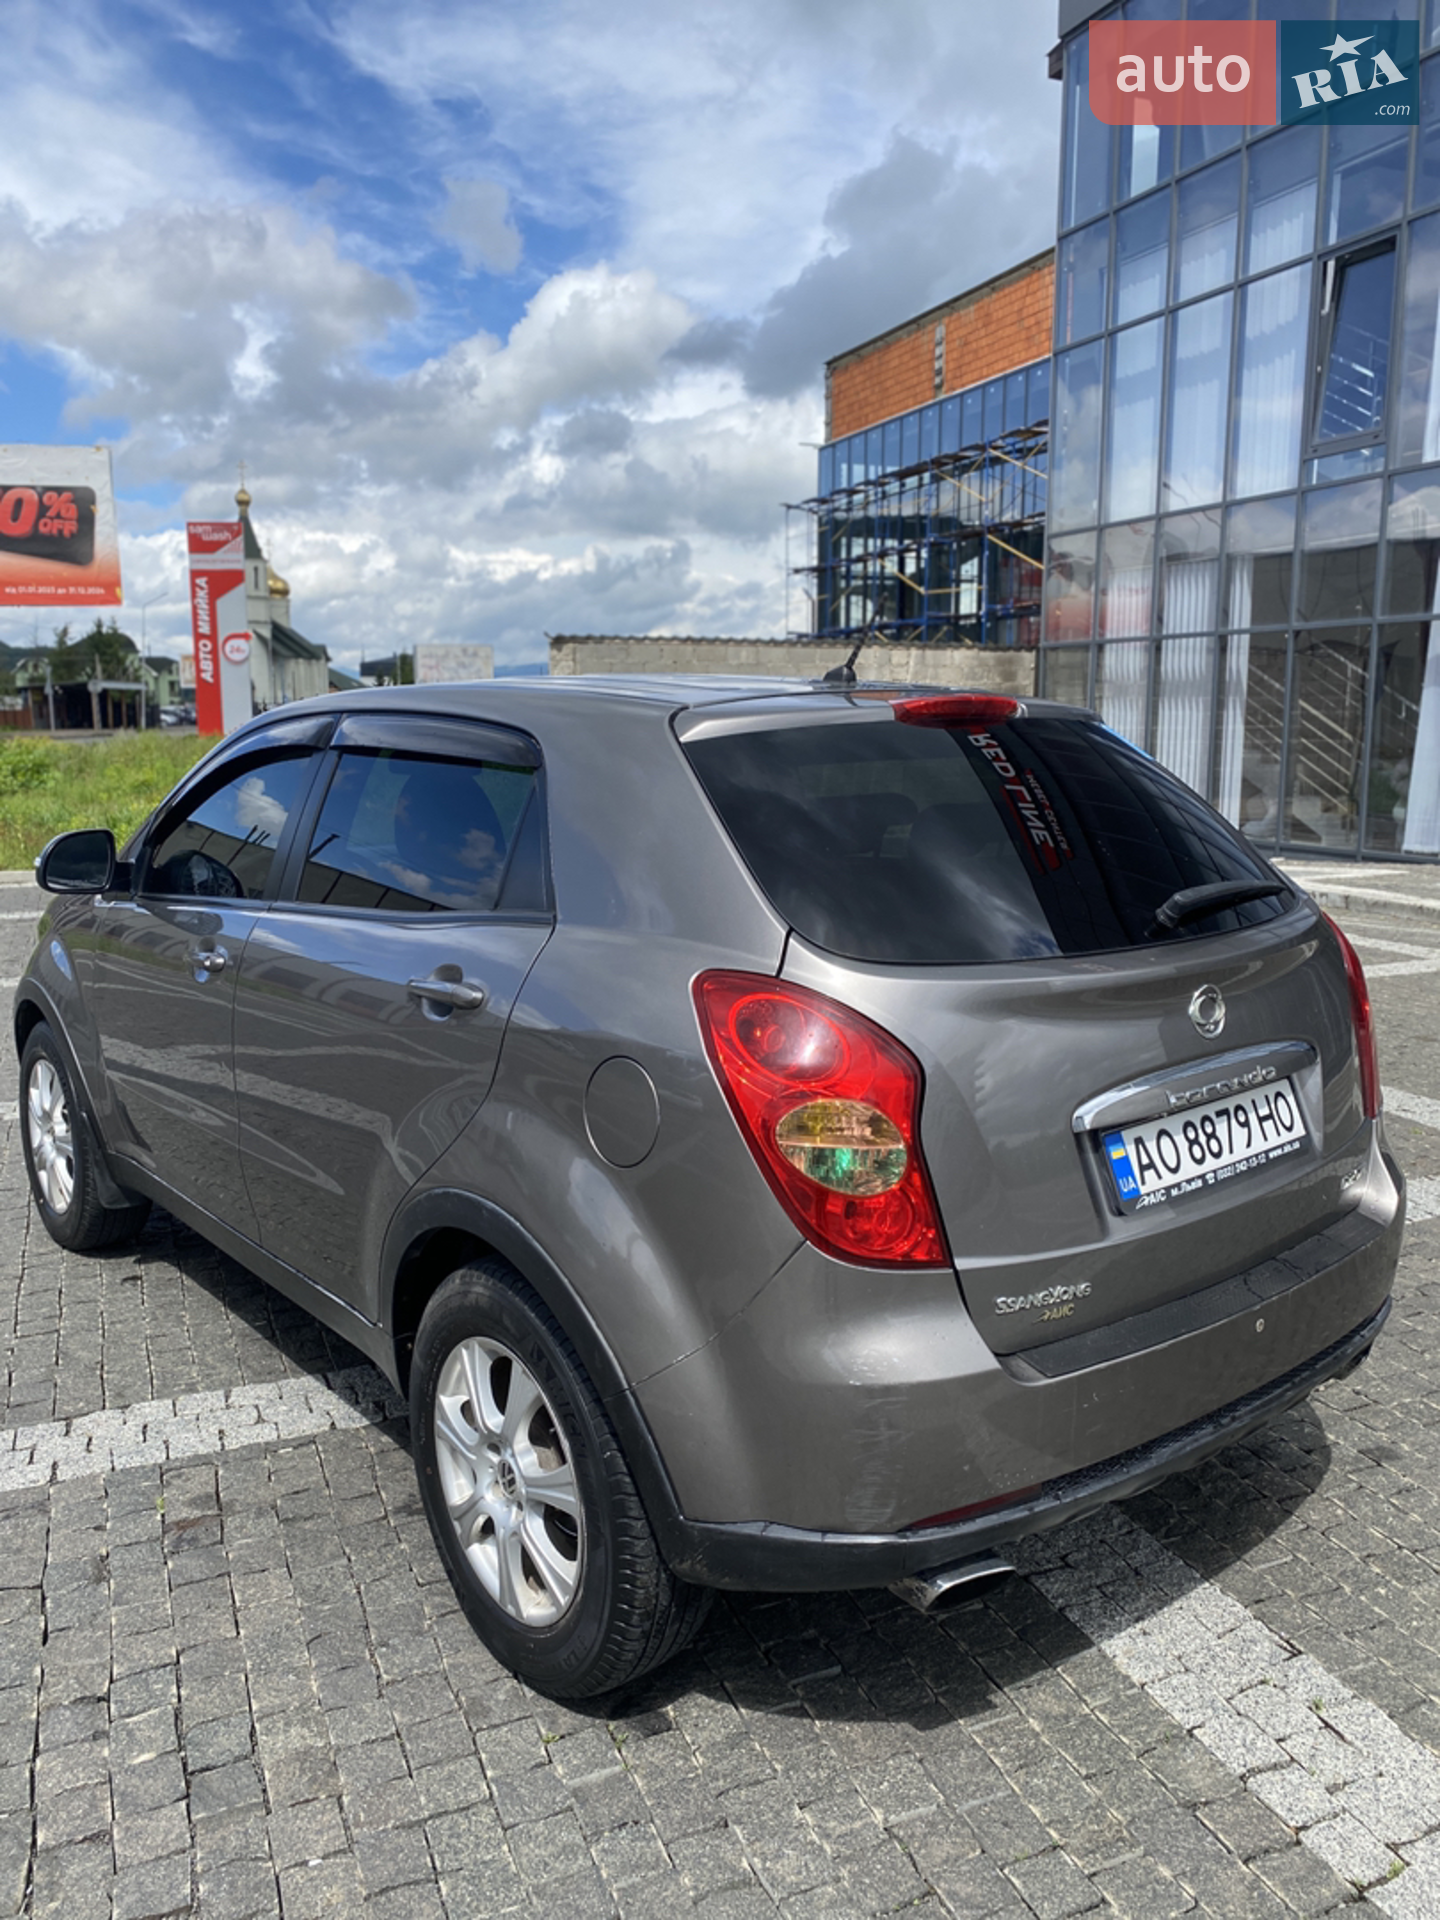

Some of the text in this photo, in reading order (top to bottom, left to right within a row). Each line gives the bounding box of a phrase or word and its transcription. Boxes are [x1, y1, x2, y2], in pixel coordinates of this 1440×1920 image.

[39, 518, 78, 538] OFF
[1182, 1103, 1252, 1165] 8879
[1119, 1176, 1137, 1194] UA
